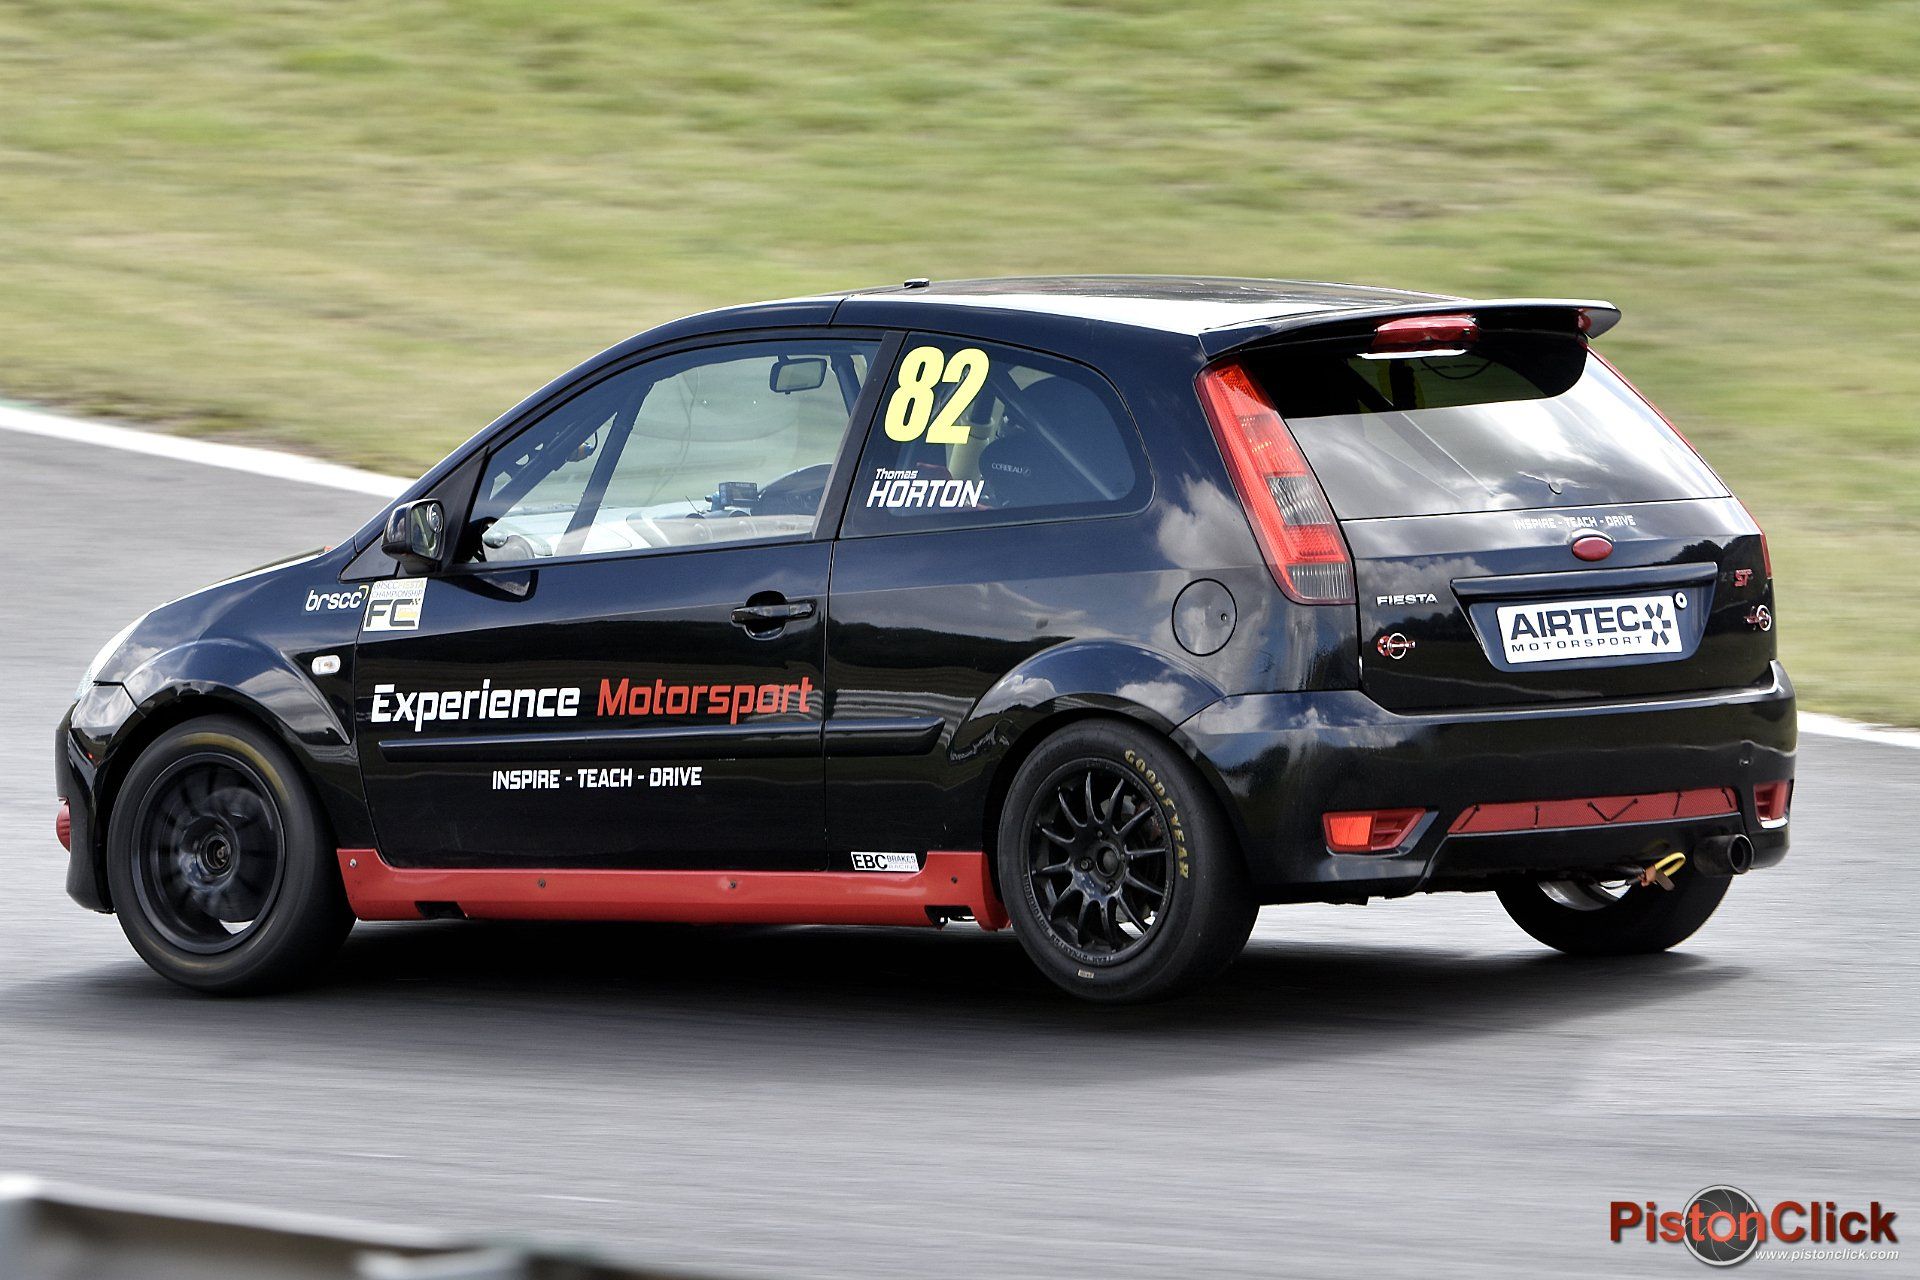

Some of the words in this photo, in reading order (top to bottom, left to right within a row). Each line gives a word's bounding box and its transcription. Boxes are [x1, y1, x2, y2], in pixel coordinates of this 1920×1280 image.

[884, 346, 990, 444] 82
[876, 468, 918, 480] Thomas
[866, 480, 984, 508] HORTON
[1513, 518, 1557, 530] INSPIRE
[1565, 516, 1598, 528] TEACH
[1605, 514, 1637, 527] DRIVE
[305, 588, 363, 612] brscc
[1377, 593, 1439, 607] FIESTA
[1511, 605, 1641, 641] AIRTEC
[1511, 636, 1643, 653] MOTORSPORT
[371, 679, 581, 732] Experience
[597, 676, 814, 725] Motorsport
[492, 769, 561, 790] INSPIRE
[577, 768, 633, 788] TEACH
[649, 766, 702, 787] DRIVE
[852, 854, 888, 870] EBC
